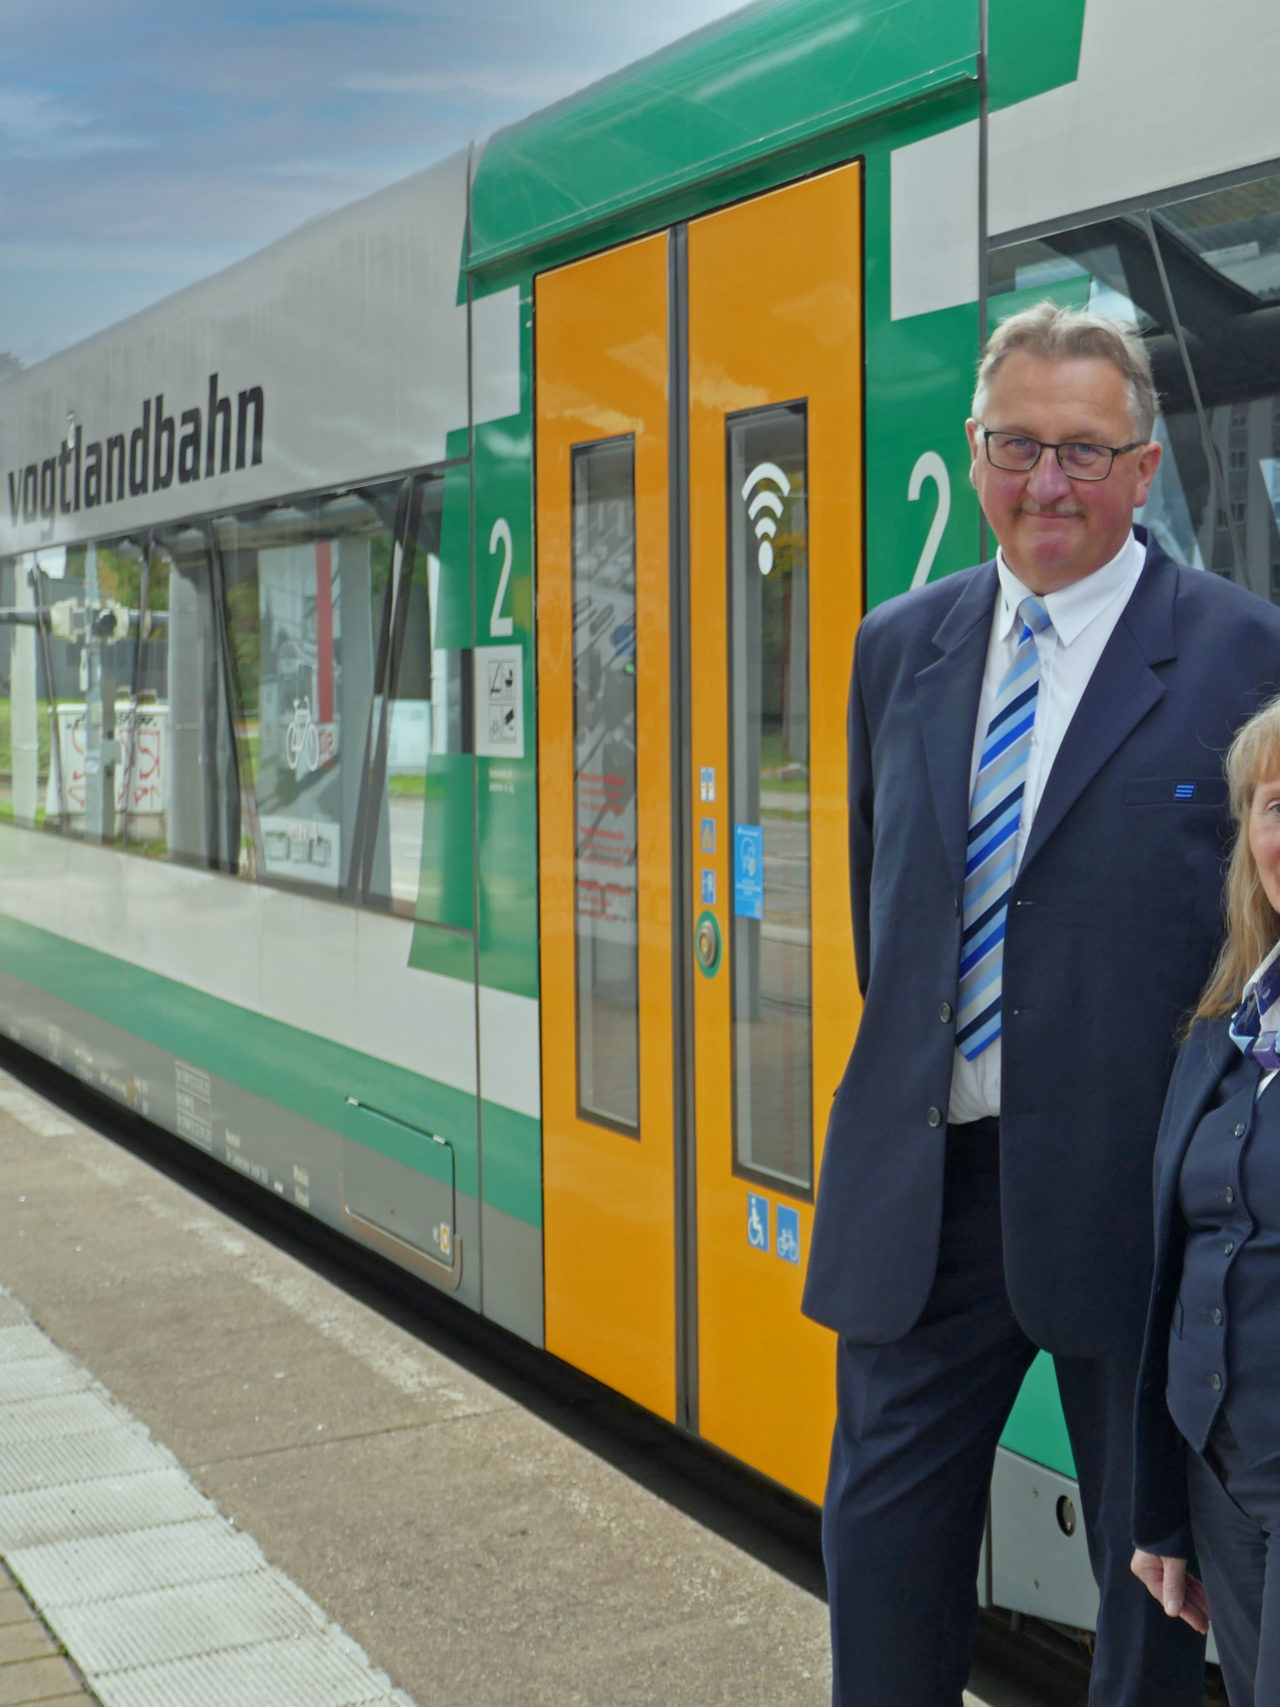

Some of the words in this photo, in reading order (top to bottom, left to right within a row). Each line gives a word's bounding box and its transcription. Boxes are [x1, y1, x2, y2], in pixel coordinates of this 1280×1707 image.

[8, 372, 265, 538] vogtlandbahn
[907, 450, 951, 591] 2
[488, 517, 513, 638] 2
